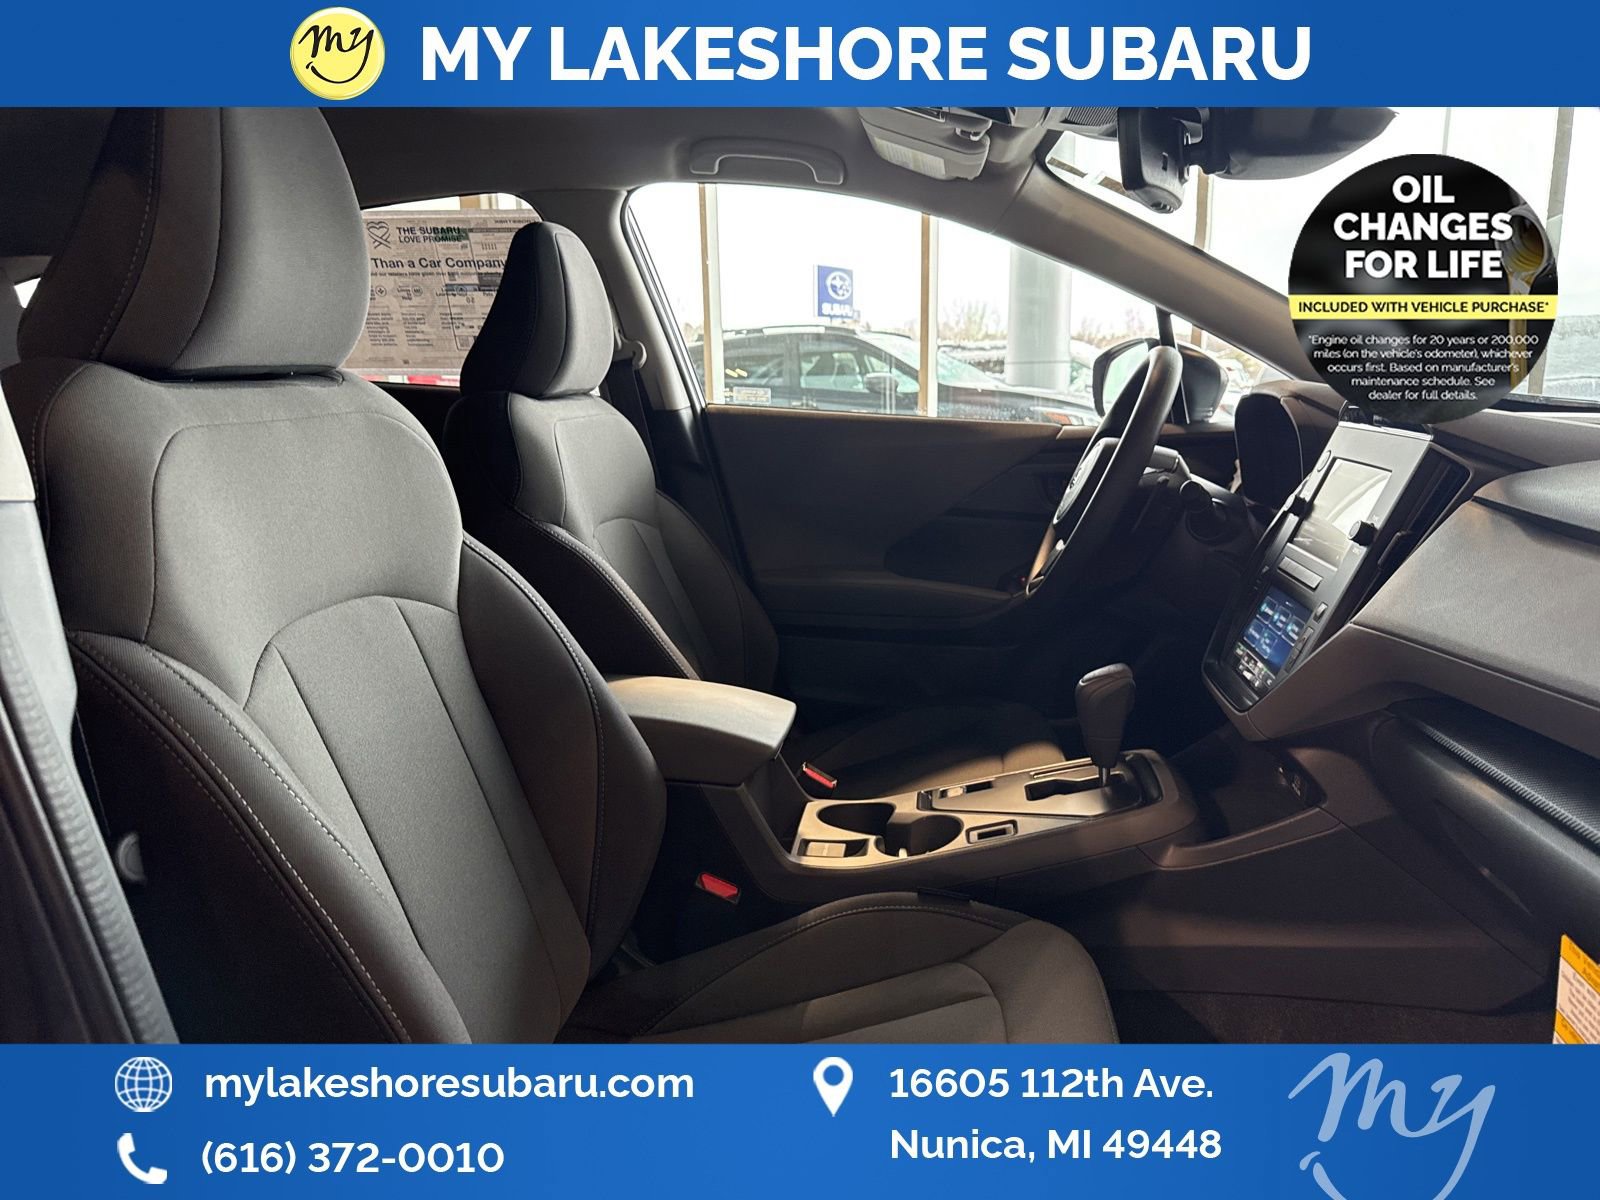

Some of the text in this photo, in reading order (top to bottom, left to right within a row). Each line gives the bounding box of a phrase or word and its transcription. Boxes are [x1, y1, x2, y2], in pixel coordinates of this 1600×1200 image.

[420, 226, 461, 234] SUBARU
[399, 235, 463, 243] LOVE PROMISE
[371, 258, 404, 268] Than
[407, 260, 415, 268] a
[419, 257, 441, 268] Car
